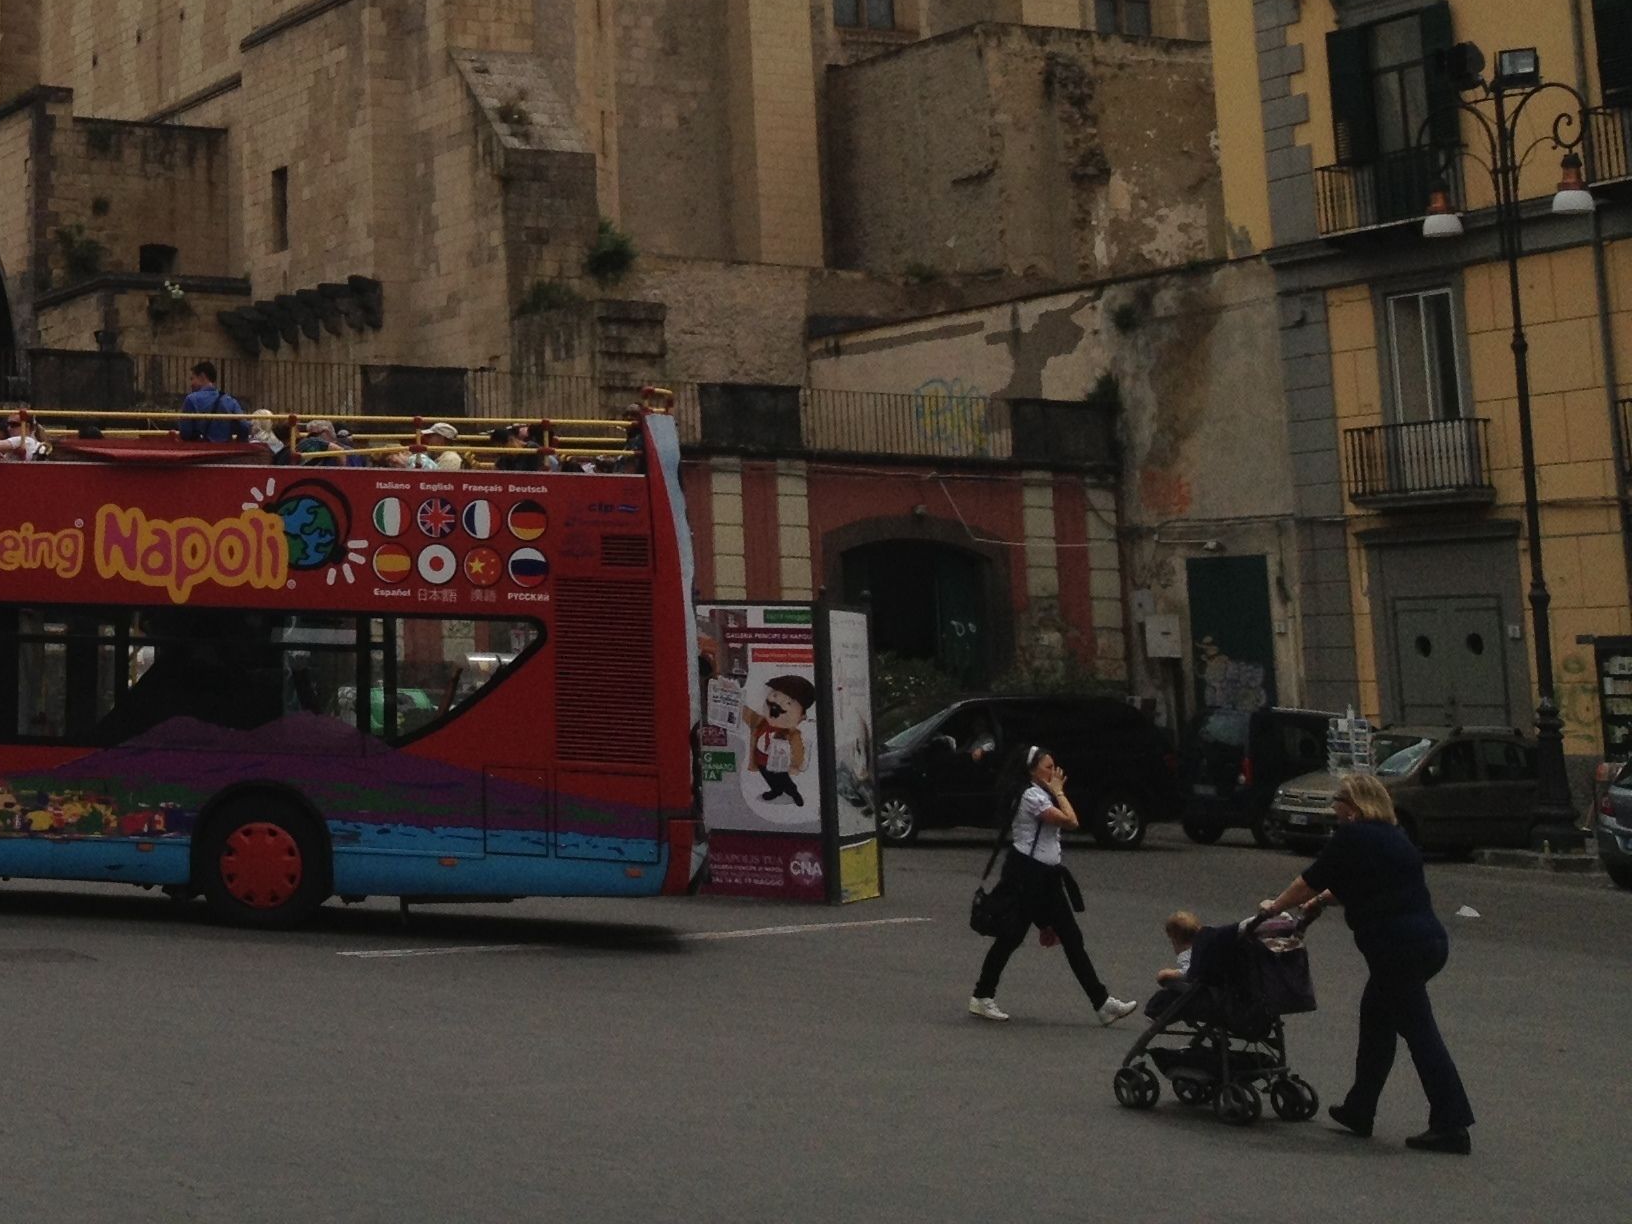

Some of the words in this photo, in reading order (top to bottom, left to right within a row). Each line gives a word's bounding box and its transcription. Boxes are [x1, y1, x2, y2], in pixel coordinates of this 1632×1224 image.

[375, 481, 411, 490] Italiano
[419, 481, 455, 492] English
[462, 482, 503, 493] Français
[508, 484, 549, 494] Deutsch
[94, 503, 289, 604] Napoli
[372, 587, 411, 598] Español
[789, 859, 824, 877] CNA
